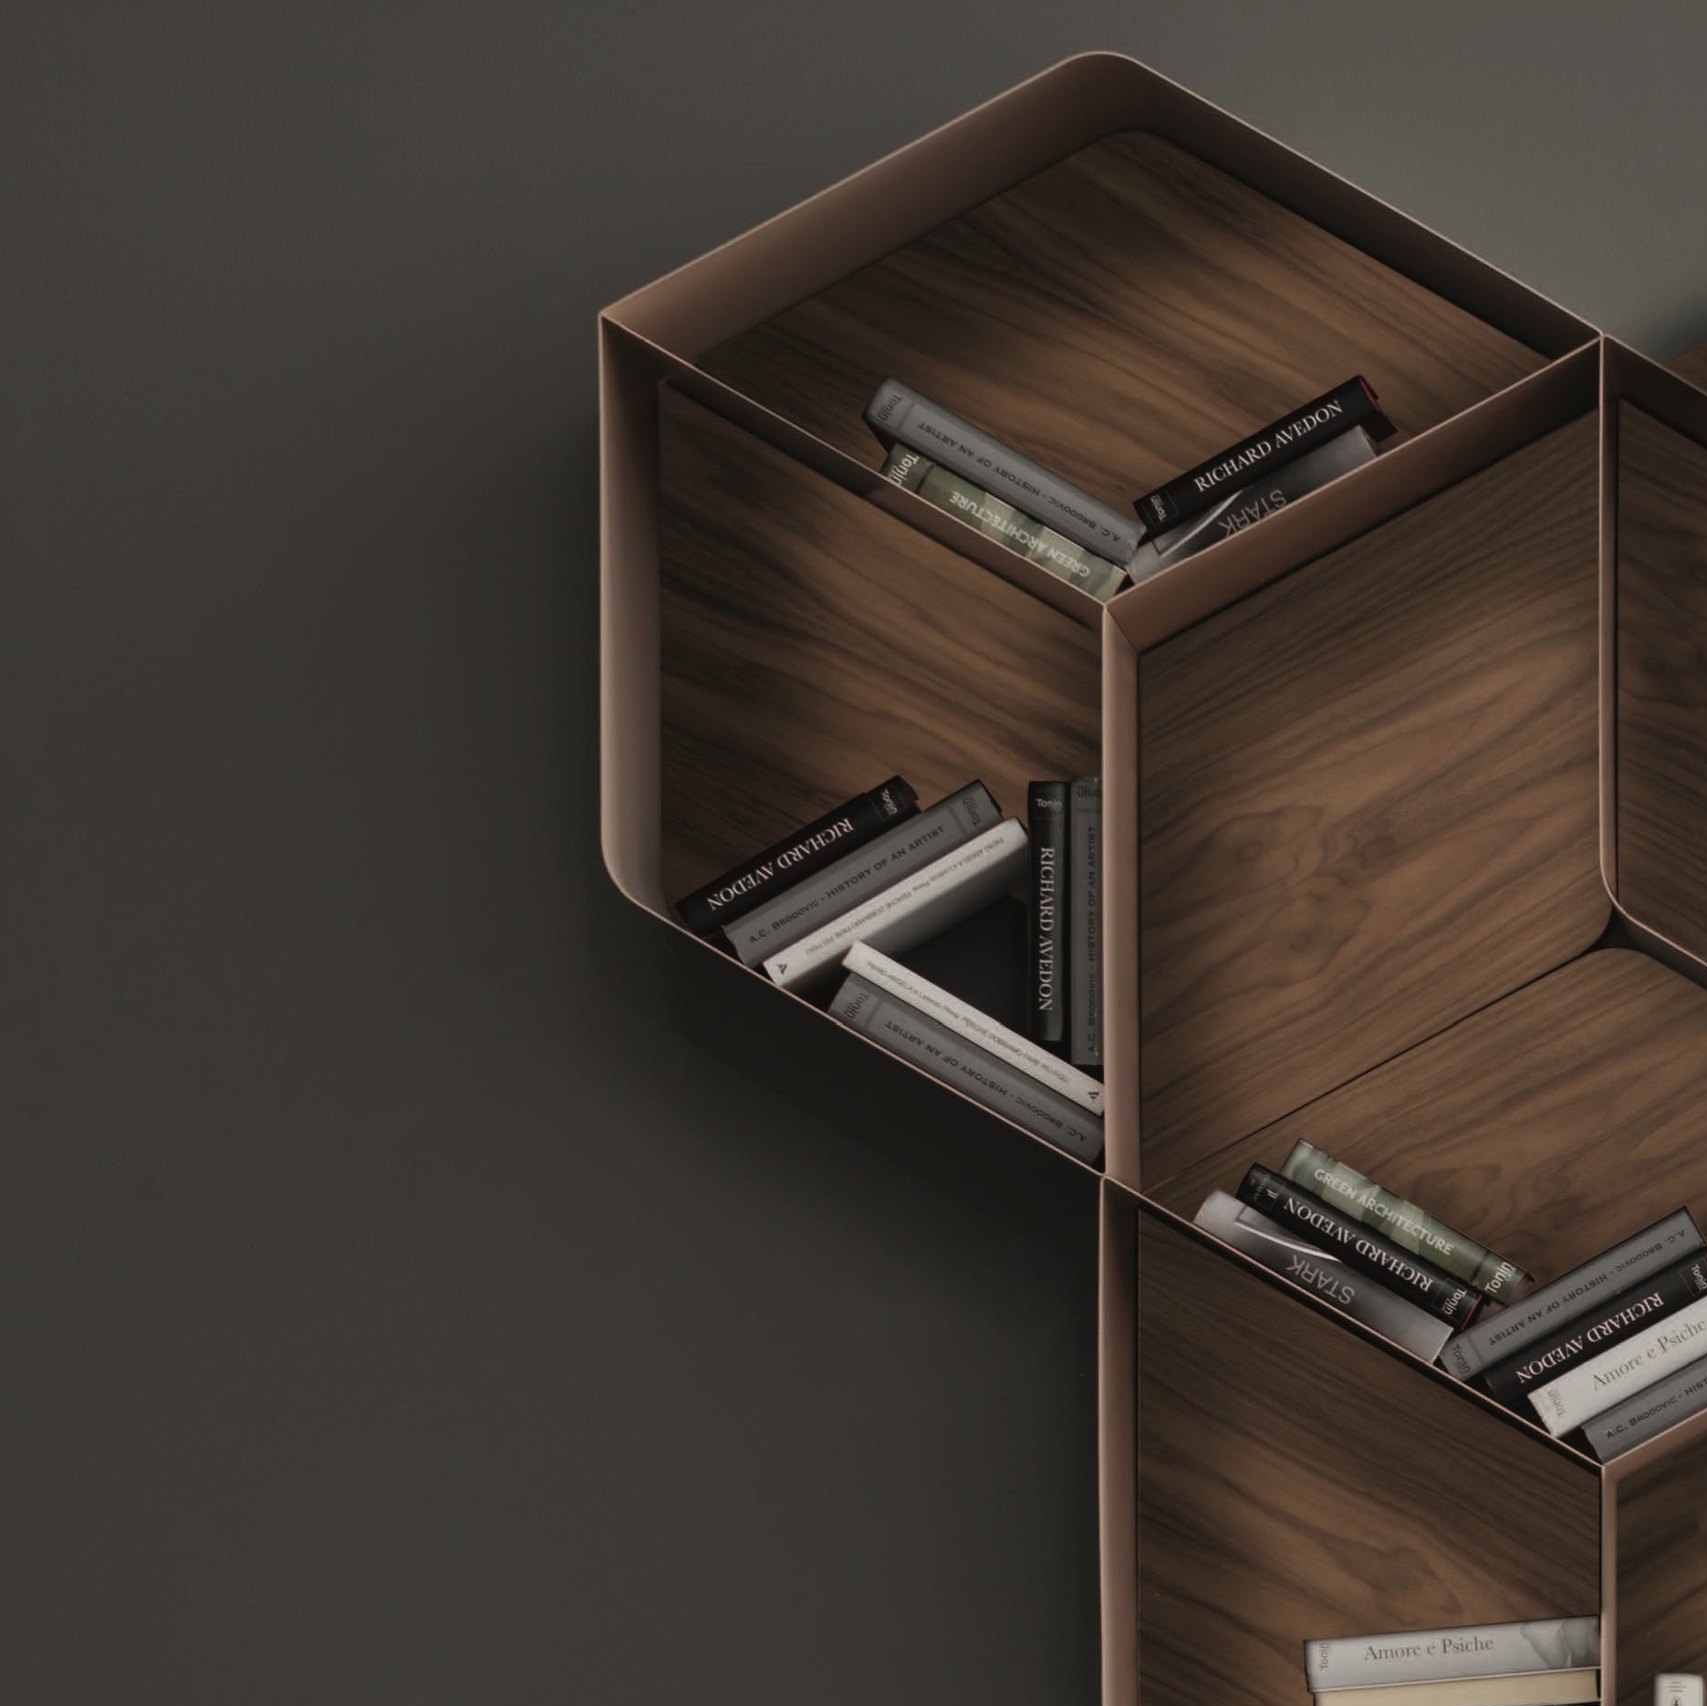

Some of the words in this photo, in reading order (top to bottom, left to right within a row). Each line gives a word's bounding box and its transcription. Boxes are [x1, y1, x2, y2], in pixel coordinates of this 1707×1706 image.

[917, 421, 957, 447] ARTIST
[958, 444, 974, 457] AN
[1193, 440, 1272, 492] RICHARD
[1272, 399, 1343, 448] AVEDON
[975, 455, 992, 468] OF
[992, 465, 1040, 496] HISTORY
[948, 490, 1047, 553] ARCHITECTURE
[1217, 488, 1289, 538] STARK
[1047, 546, 1091, 577] GREEN
[775, 817, 853, 869] RICHARD
[706, 861, 775, 910] AVEDON
[1039, 847, 1054, 930] RICHARD
[1038, 935, 1053, 1010] AVEDON
[1282, 1196, 1356, 1245] AVEDON
[1312, 1167, 1358, 1199] GREEN
[1356, 1193, 1455, 1255] ARCHITECTURE
[1284, 1254, 1356, 1305] STARK
[1354, 1238, 1433, 1291] RICHARD
[1585, 1292, 1664, 1343] RICHARD
[1515, 1335, 1584, 1383] AVEDON
[1590, 1353, 1643, 1390] Amore
[1656, 1318, 1706, 1353] Psiche
[1364, 1644, 1420, 1660] Amore
[1441, 1635, 1493, 1654] Psiche
